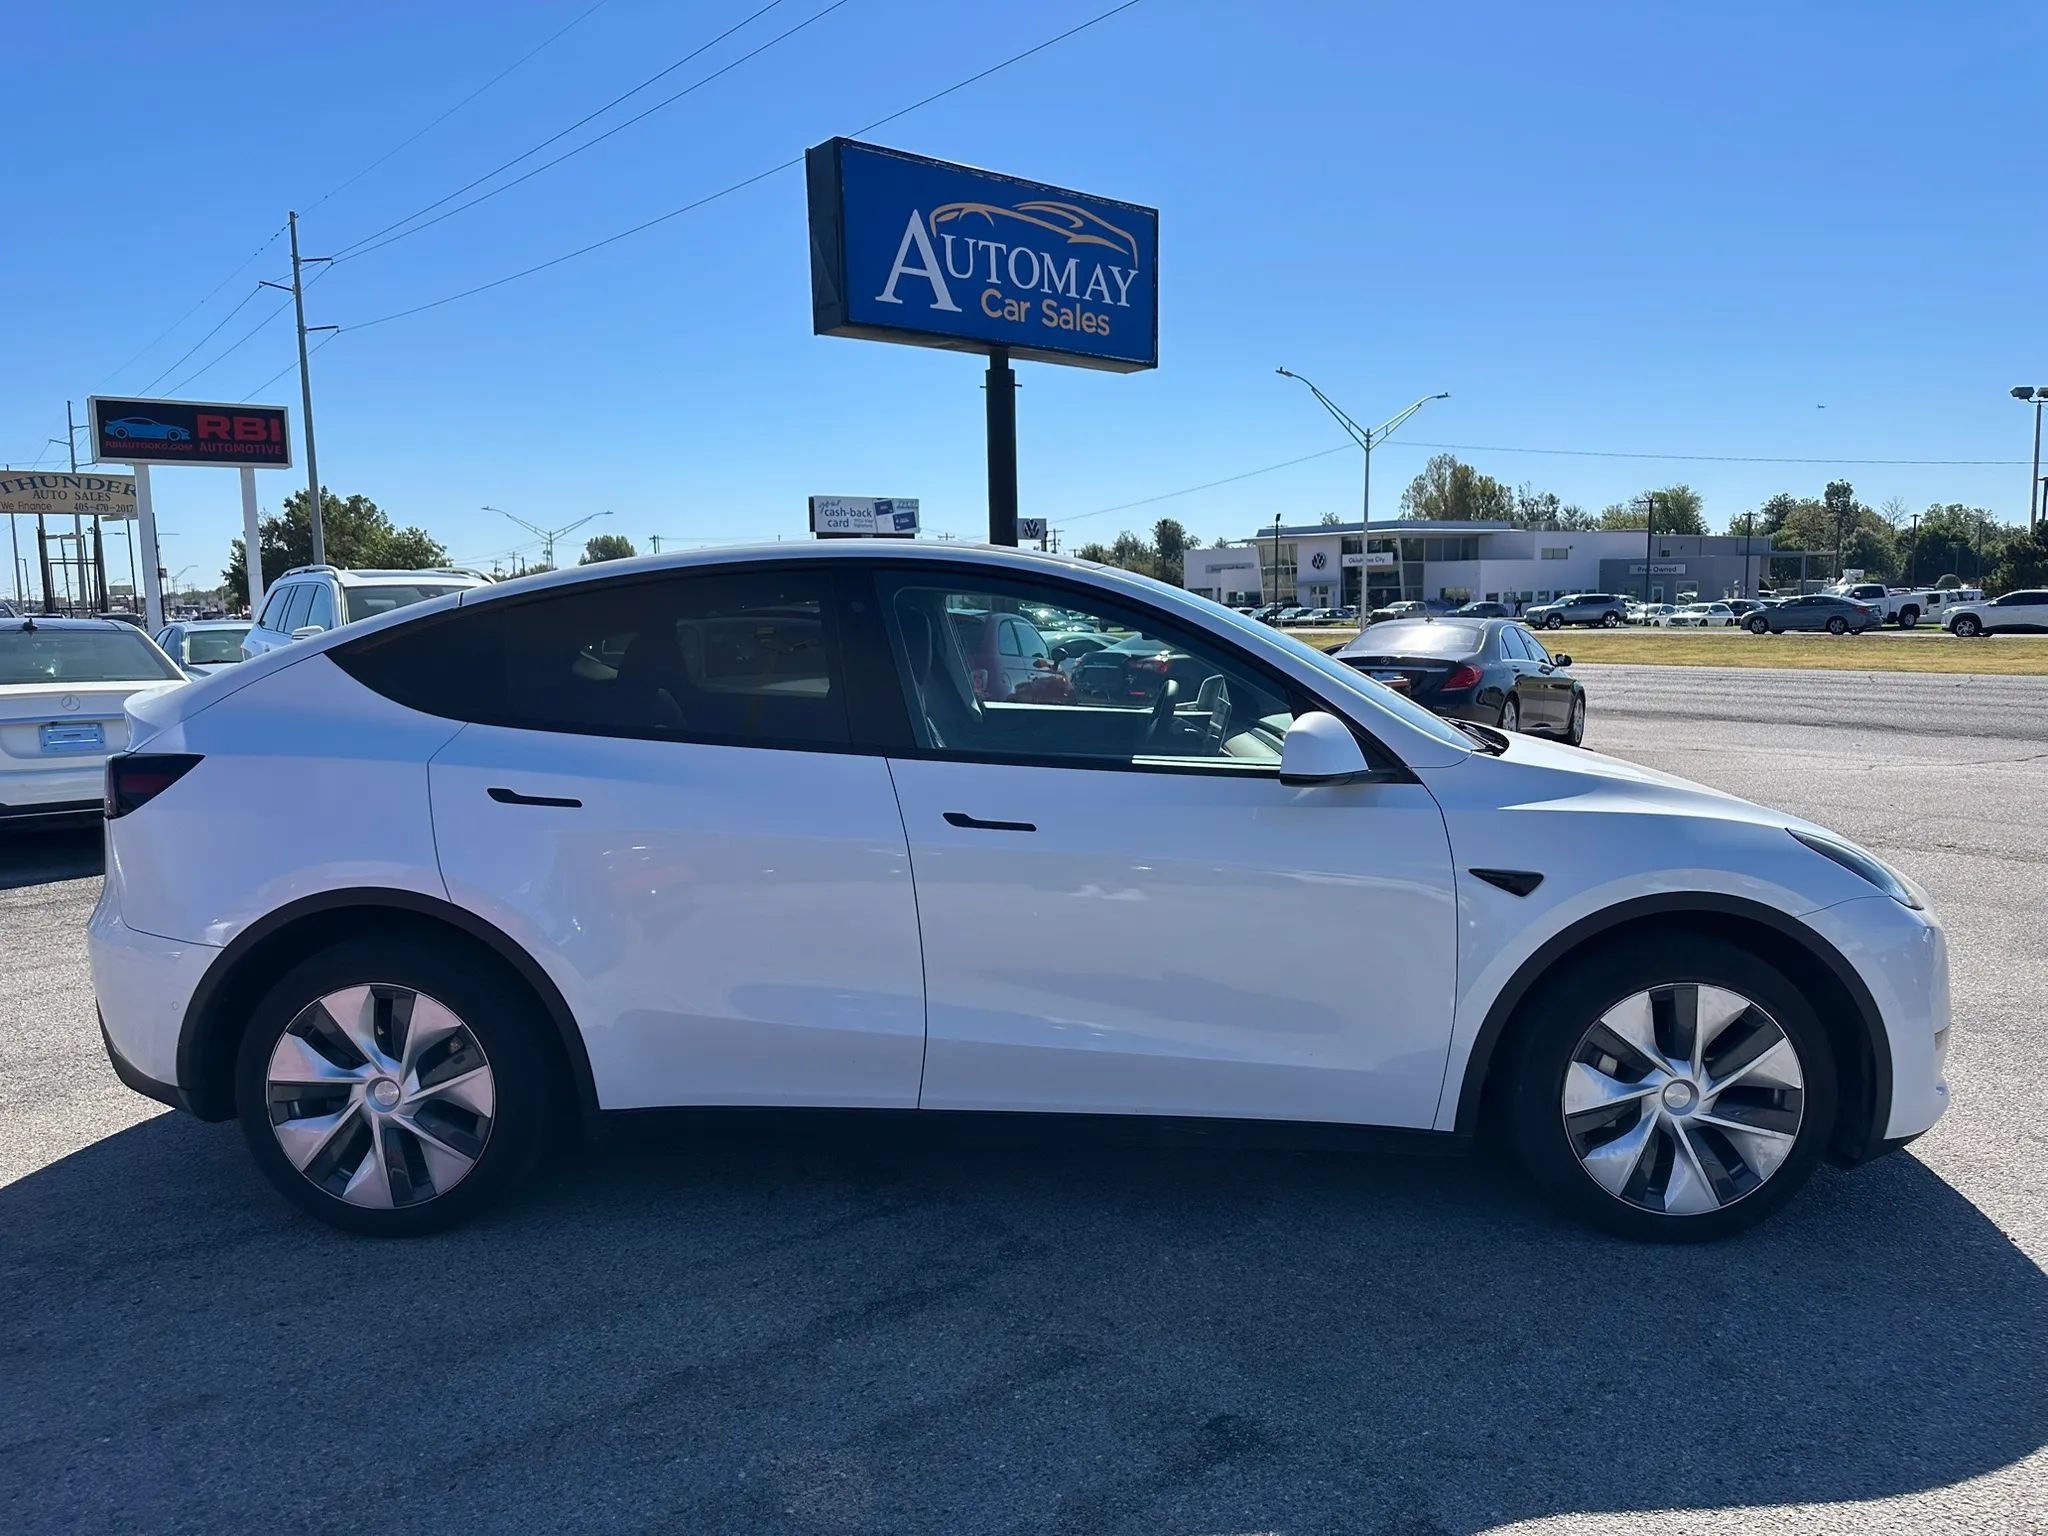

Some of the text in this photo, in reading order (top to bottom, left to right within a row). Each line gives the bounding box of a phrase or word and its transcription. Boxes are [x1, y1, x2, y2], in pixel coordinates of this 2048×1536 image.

[874, 208, 1139, 312] AUTOMAY
[980, 288, 1110, 336] Car Sales
[196, 413, 282, 442] RBI
[199, 441, 282, 455] AUTOMOTIVE
[0, 475, 137, 498] THUNDER
[33, 490, 112, 502] AUTO SALES
[1, 501, 52, 511] We Finance
[74, 503, 134, 513] 405-470-2017
[825, 507, 873, 518] cash-back
[827, 518, 849, 528] card
